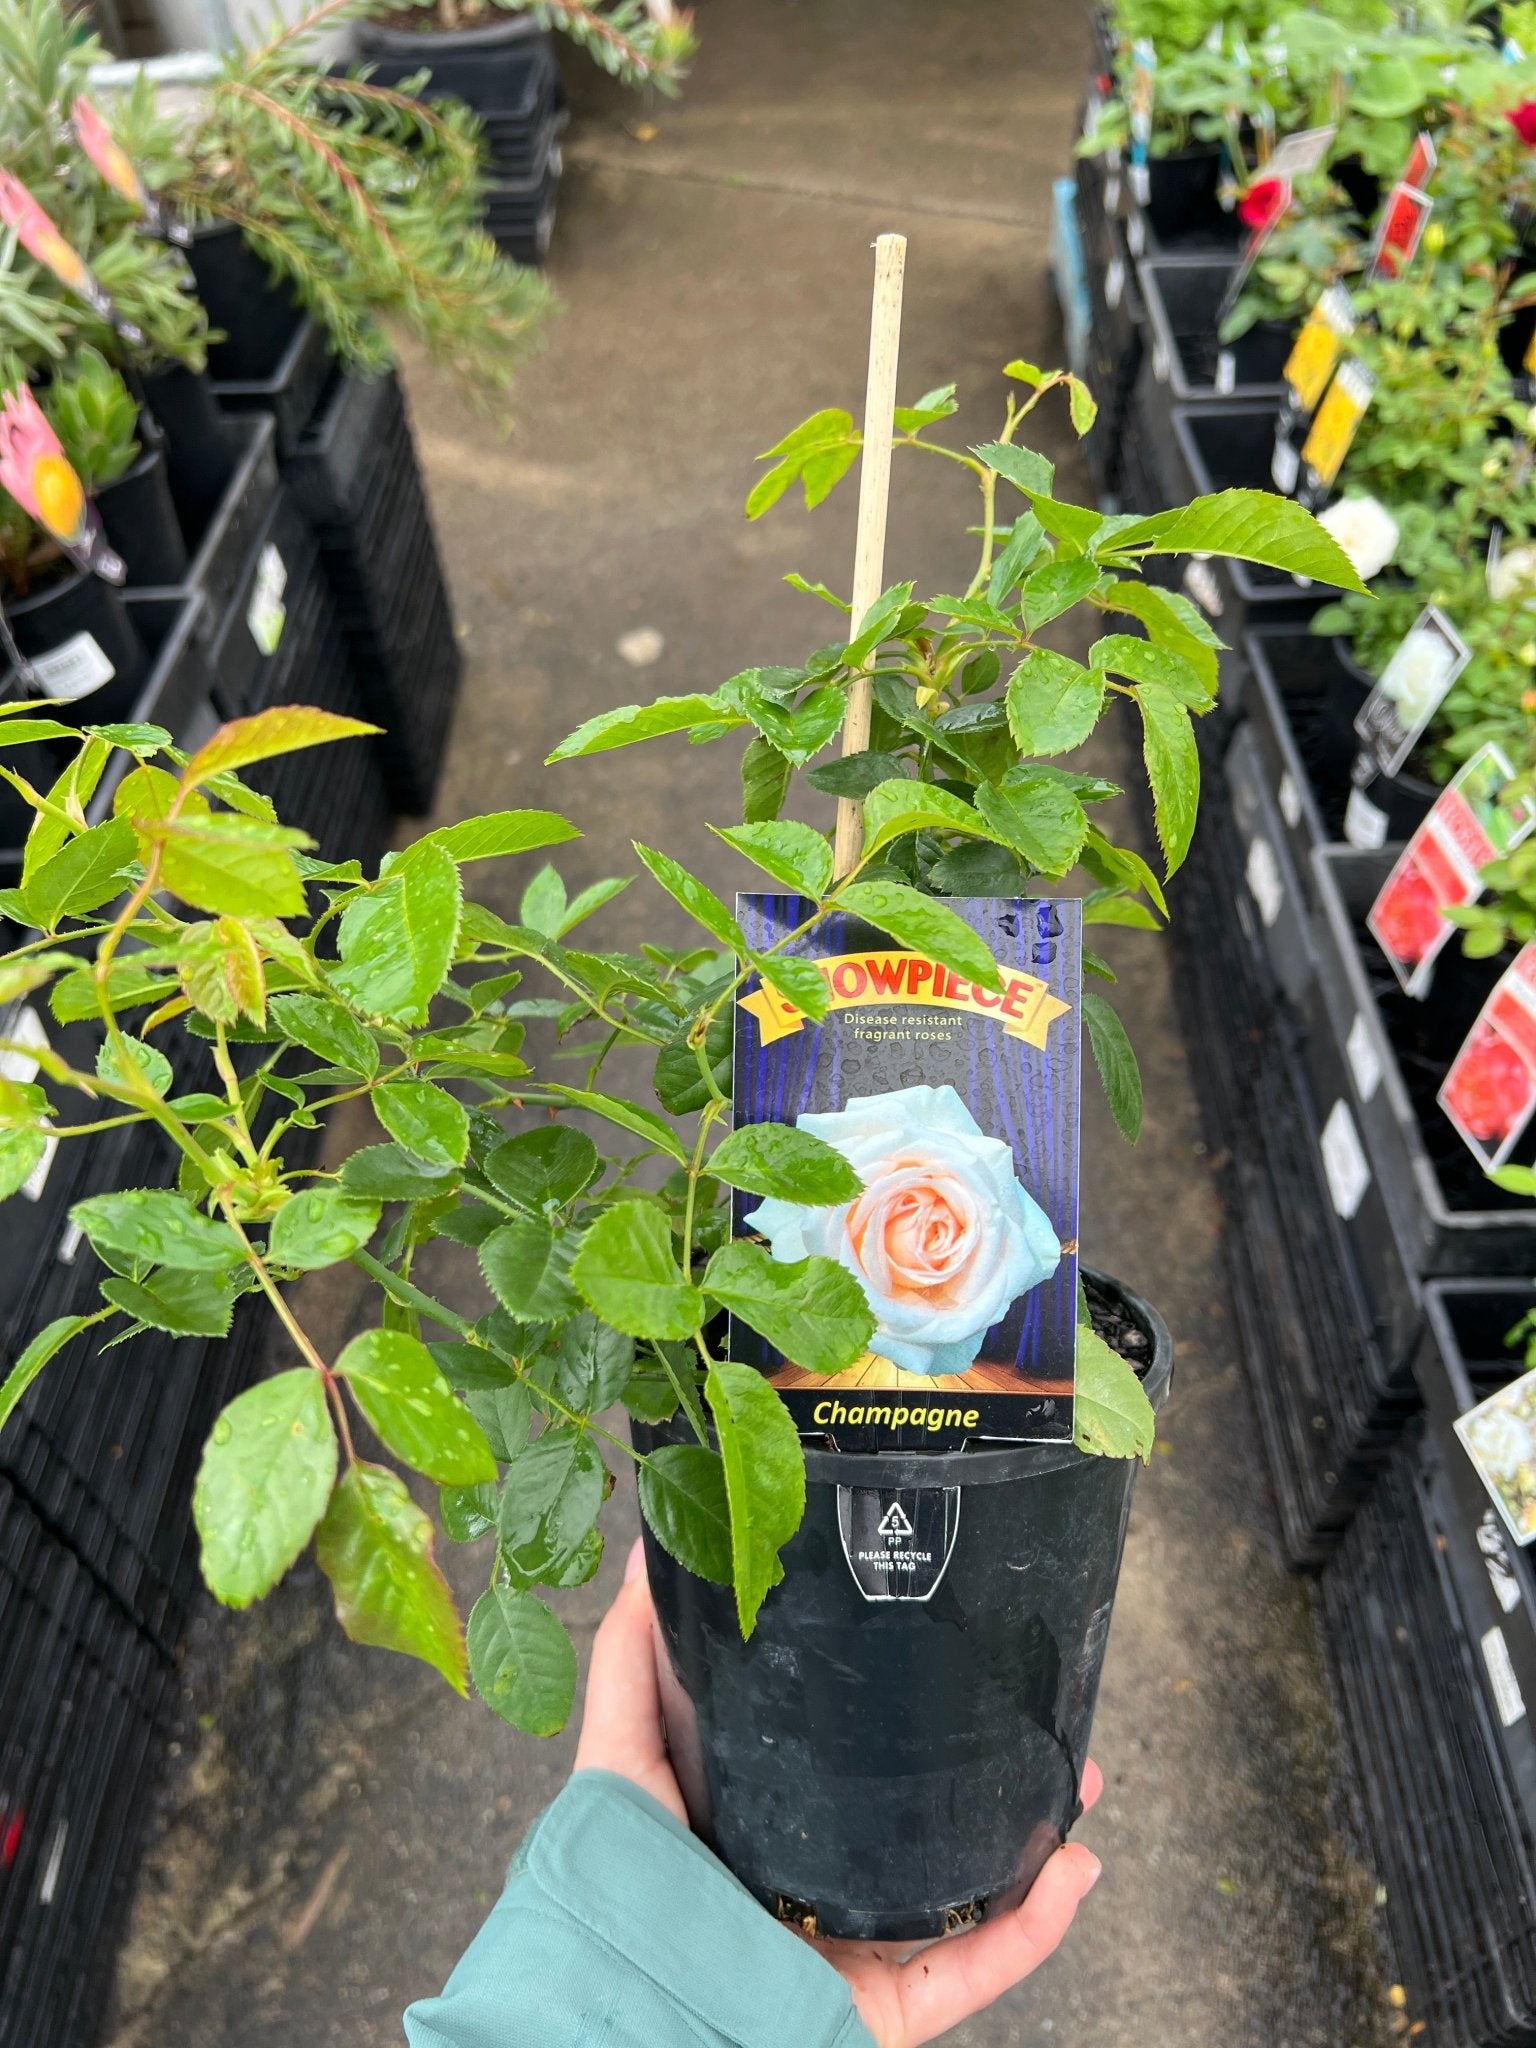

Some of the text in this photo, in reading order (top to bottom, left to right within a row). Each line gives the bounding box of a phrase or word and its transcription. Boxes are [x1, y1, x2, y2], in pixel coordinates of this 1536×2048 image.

[777, 959, 1034, 1019] OWPIECE
[844, 1013, 963, 1026] Disease resistant
[854, 1029, 952, 1042] fragrant roses
[813, 1400, 980, 1431] Champagne
[888, 1536, 902, 1546] PP
[858, 1551, 932, 1562] PLEASE RECYCLE
[873, 1561, 916, 1572] THIS TAG
